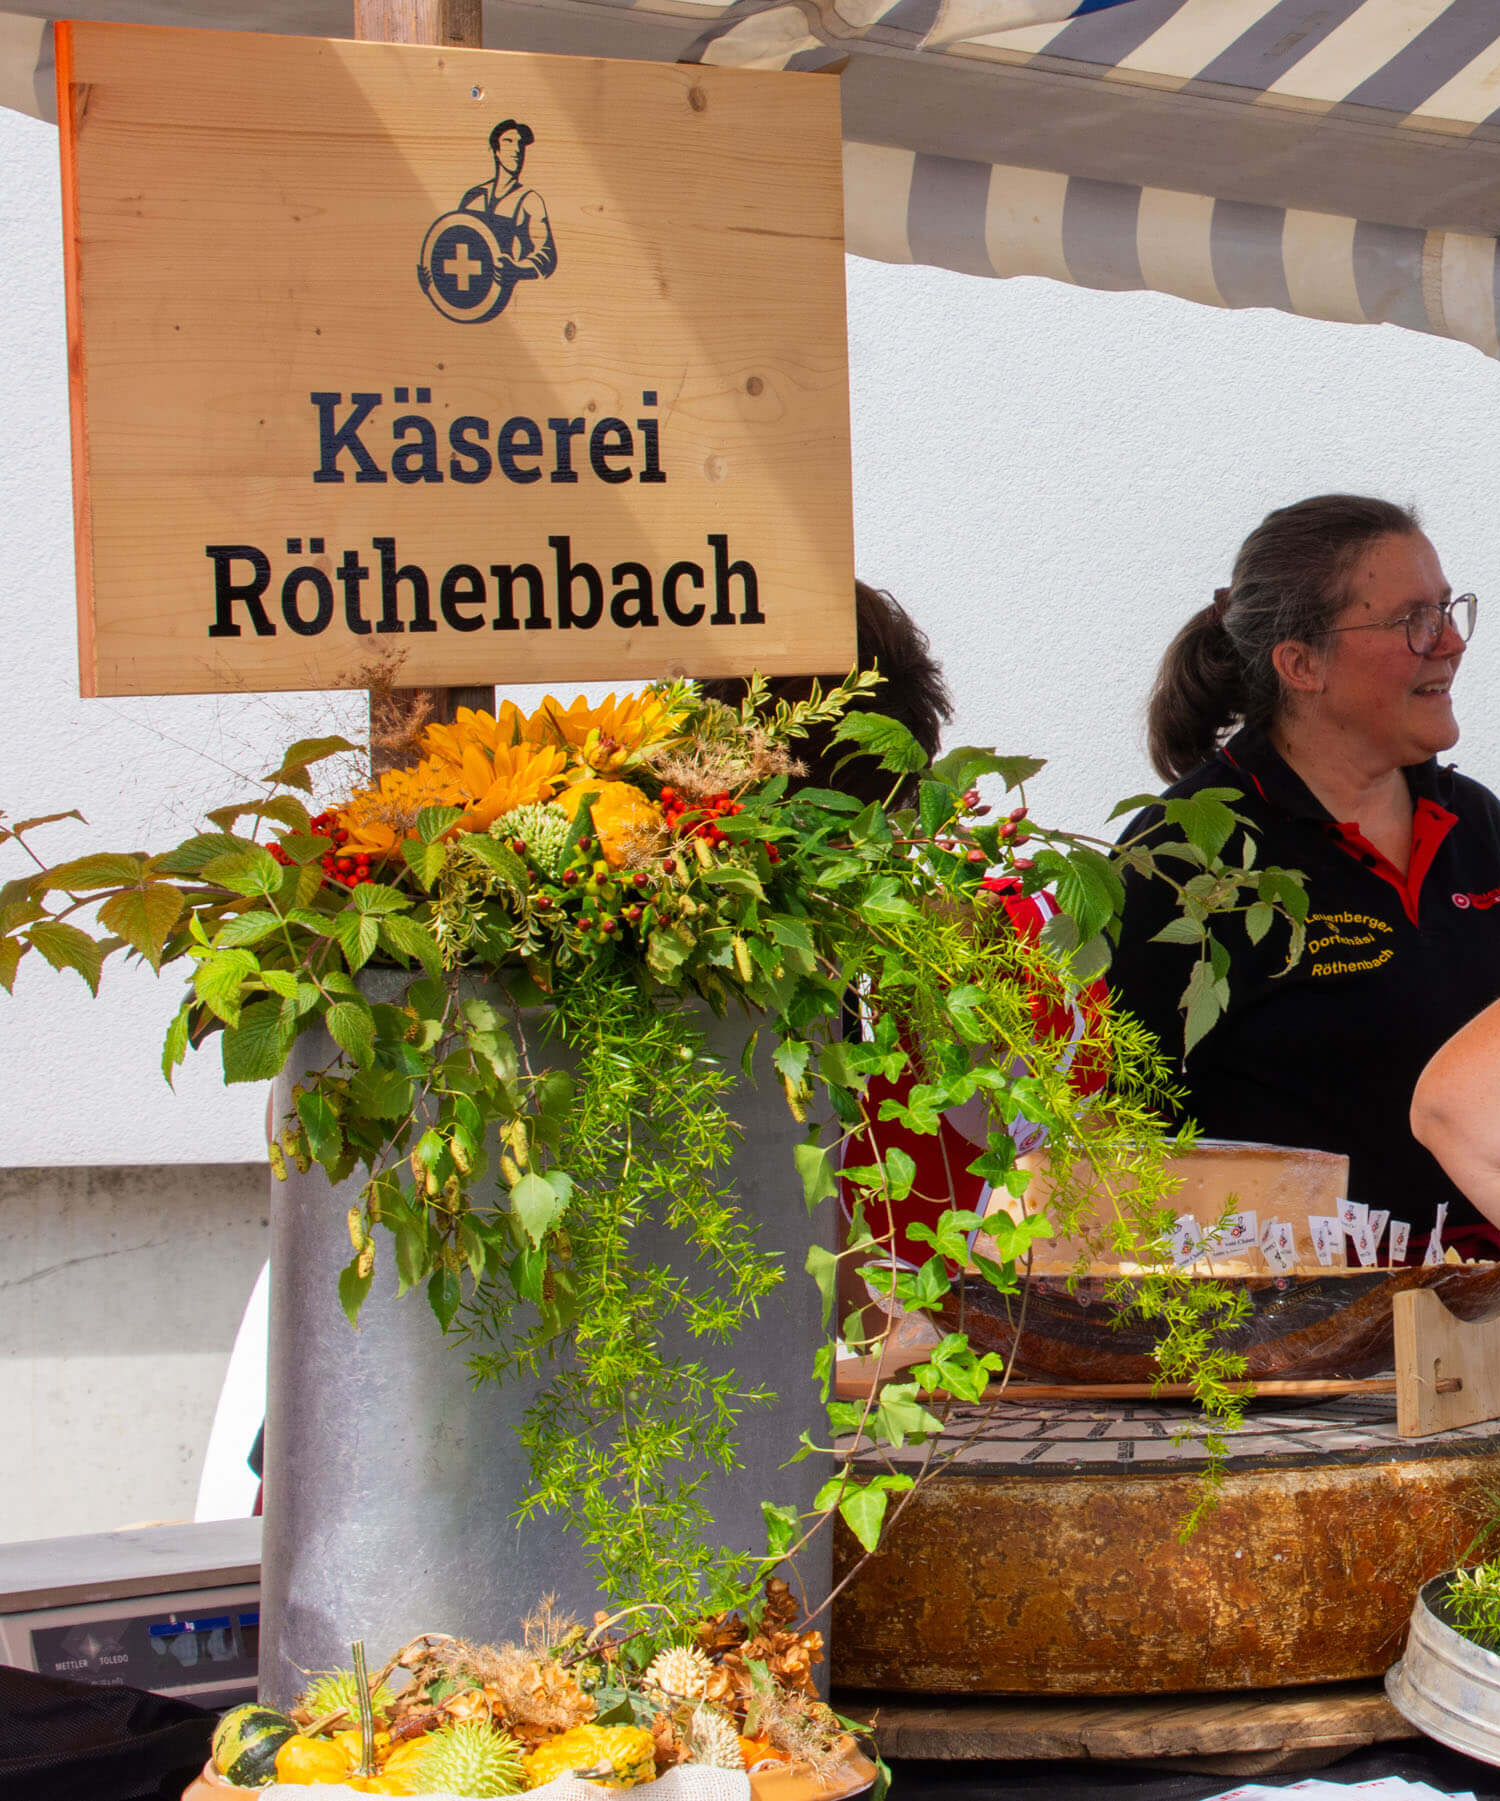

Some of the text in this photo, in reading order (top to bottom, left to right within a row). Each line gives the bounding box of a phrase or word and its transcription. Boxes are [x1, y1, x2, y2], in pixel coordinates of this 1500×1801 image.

[310, 388, 666, 485] Käserei
[205, 534, 765, 638] Röthenbach
[1312, 949, 1394, 976] Röthenbach
[55, 1655, 129, 1672] METTLER TOLEDO
